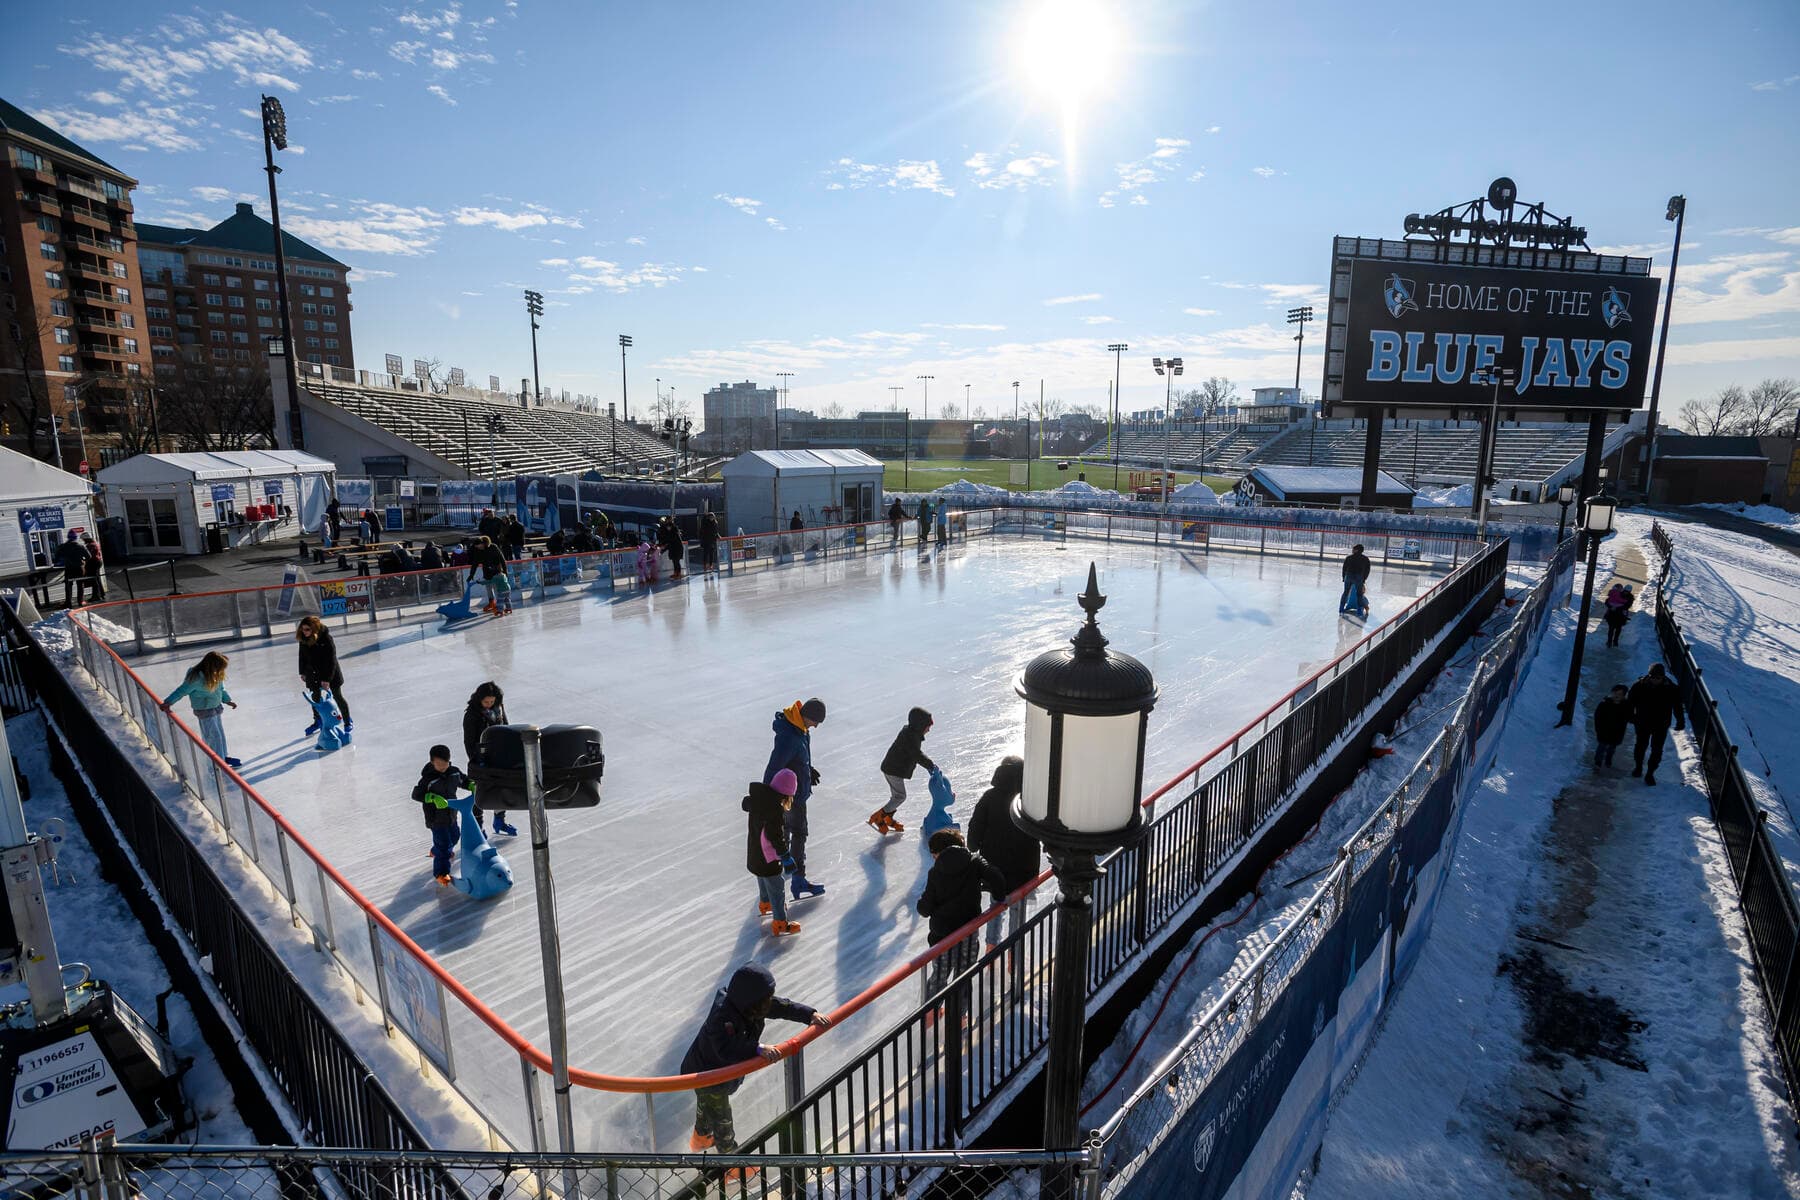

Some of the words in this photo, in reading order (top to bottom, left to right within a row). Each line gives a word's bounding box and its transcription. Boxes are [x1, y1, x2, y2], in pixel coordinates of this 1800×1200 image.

[1425, 283, 1501, 311] HOME
[1507, 287, 1539, 313] OF
[1545, 289, 1592, 316] THE
[1366, 329, 1504, 384] BLUE
[1515, 336, 1632, 395] JAYS
[1240, 477, 1256, 498] GO
[346, 583, 368, 593] 1971
[30, 1042, 85, 1069] 11966557
[55, 1064, 96, 1084] United
[56, 1071, 101, 1093] Rentals
[44, 1119, 114, 1151] ENERAC
